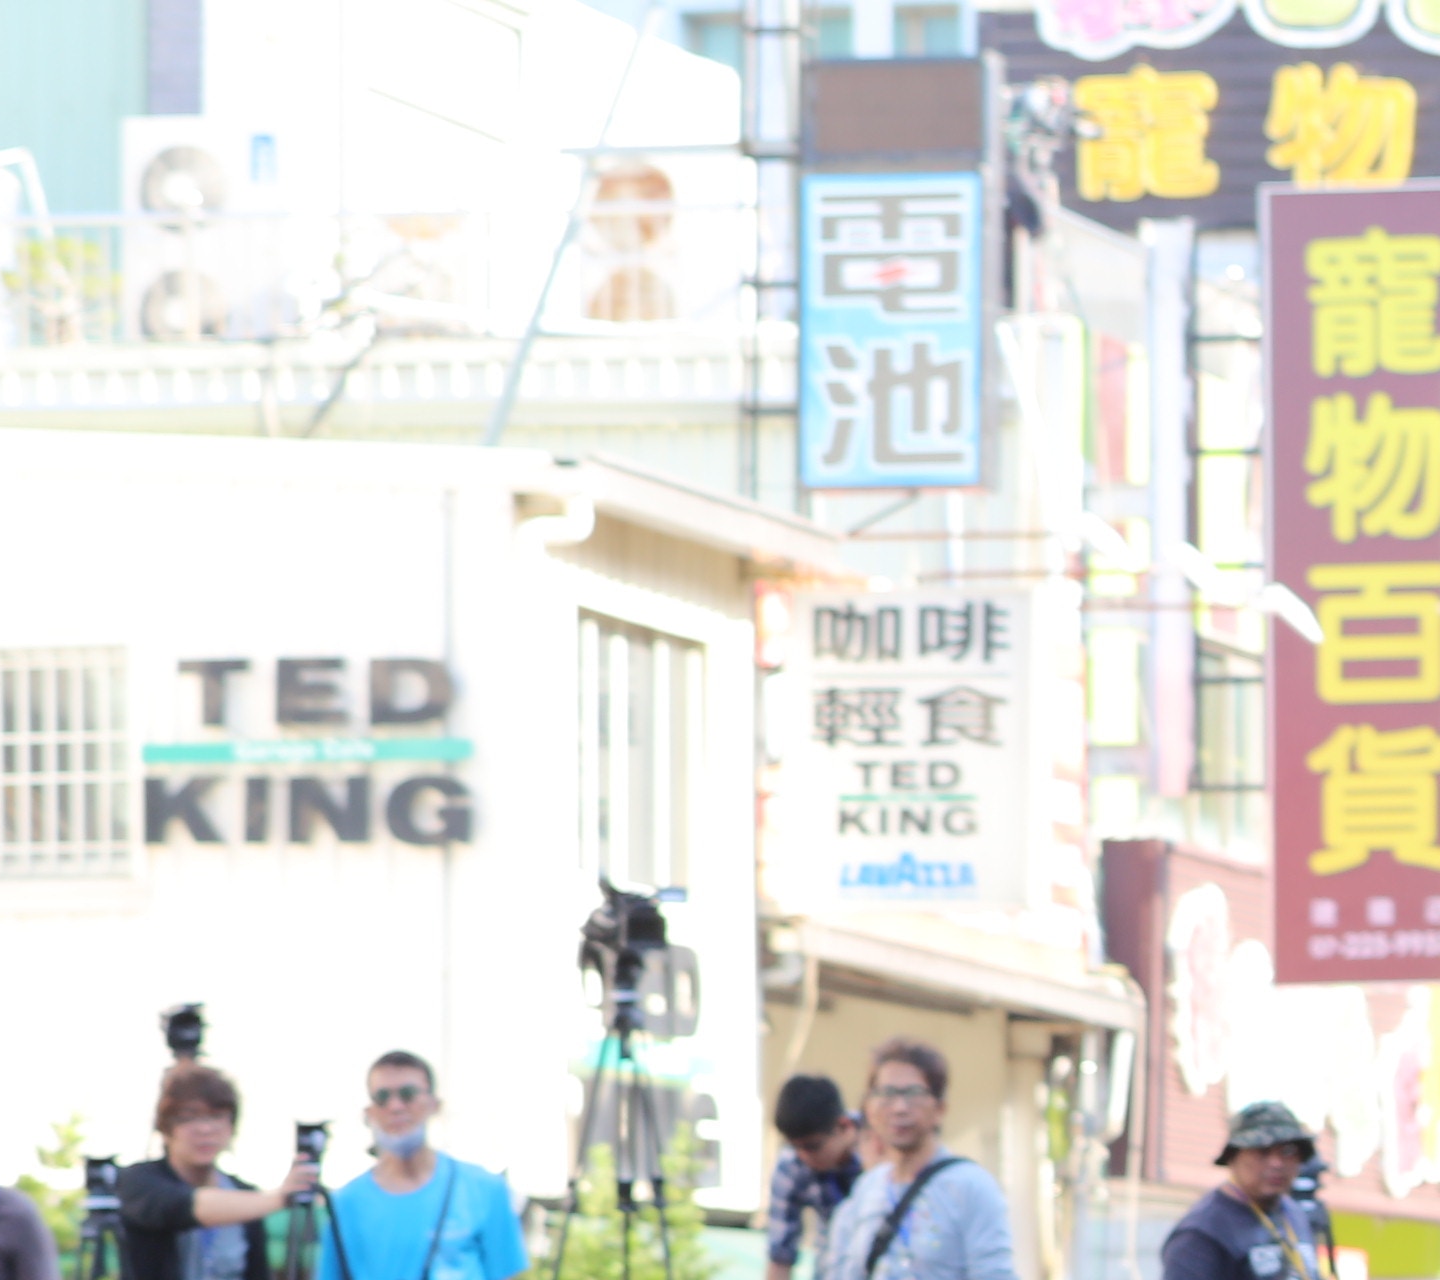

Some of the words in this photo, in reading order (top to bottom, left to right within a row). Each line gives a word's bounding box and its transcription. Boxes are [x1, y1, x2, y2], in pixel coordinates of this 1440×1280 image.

[821, 193, 967, 466] 電池
[813, 600, 1011, 663] 咖啡
[177, 657, 457, 727] TED
[811, 685, 1009, 748] 輕食
[855, 760, 963, 791] TED
[143, 774, 475, 846] KING
[838, 806, 980, 837] KING
